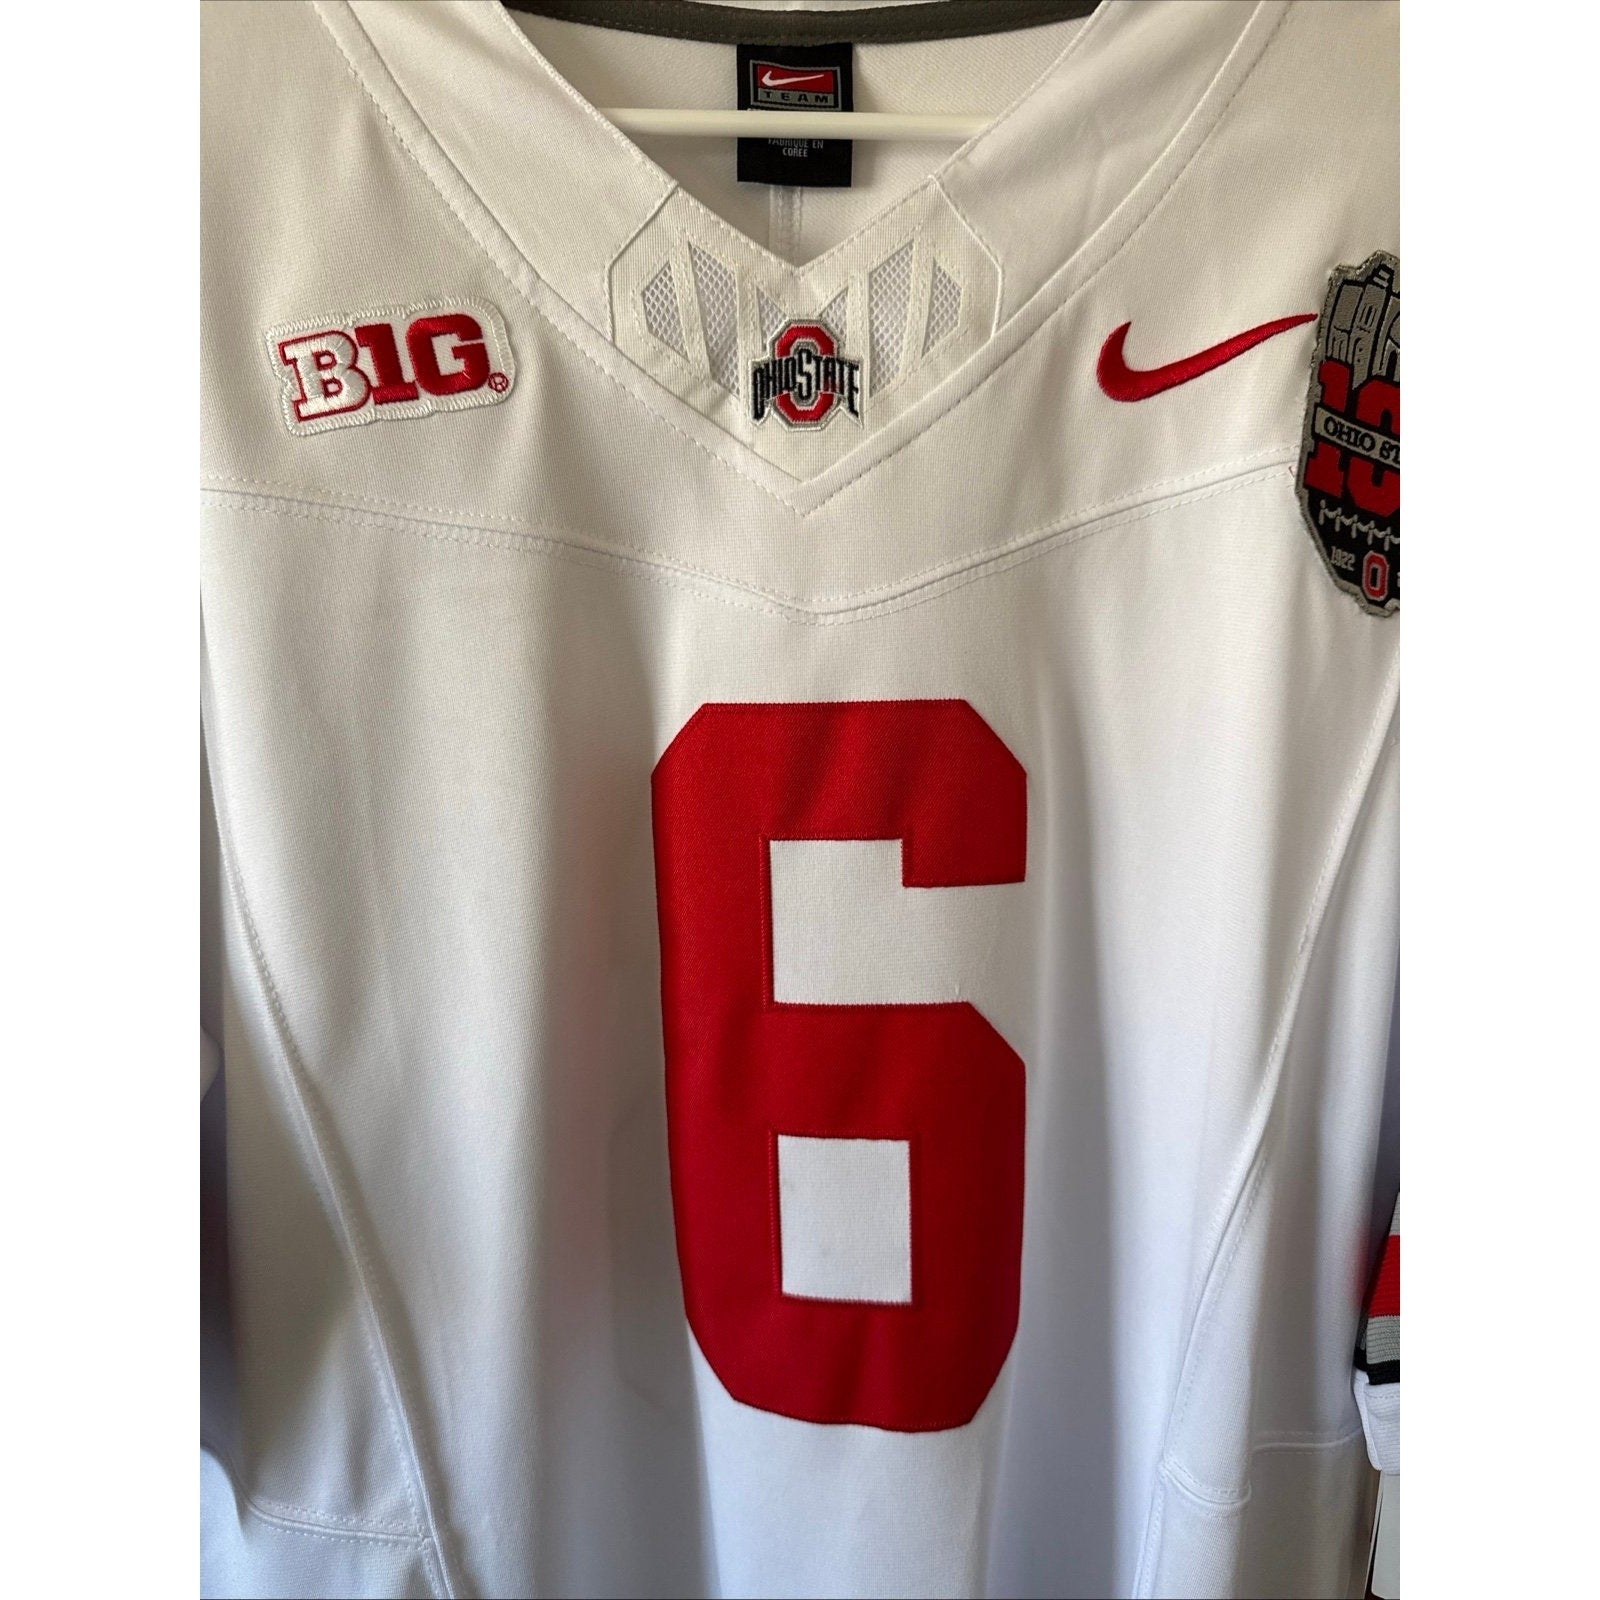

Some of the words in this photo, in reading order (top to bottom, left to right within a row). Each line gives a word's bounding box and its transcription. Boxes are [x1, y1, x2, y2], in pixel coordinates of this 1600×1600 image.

[764, 90, 829, 104] TEAM
[812, 139, 824, 149] EN
[753, 356, 797, 421] OHIO
[797, 347, 860, 418] STATE
[1323, 416, 1376, 452] OHIO
[651, 699, 1028, 1433] 6
